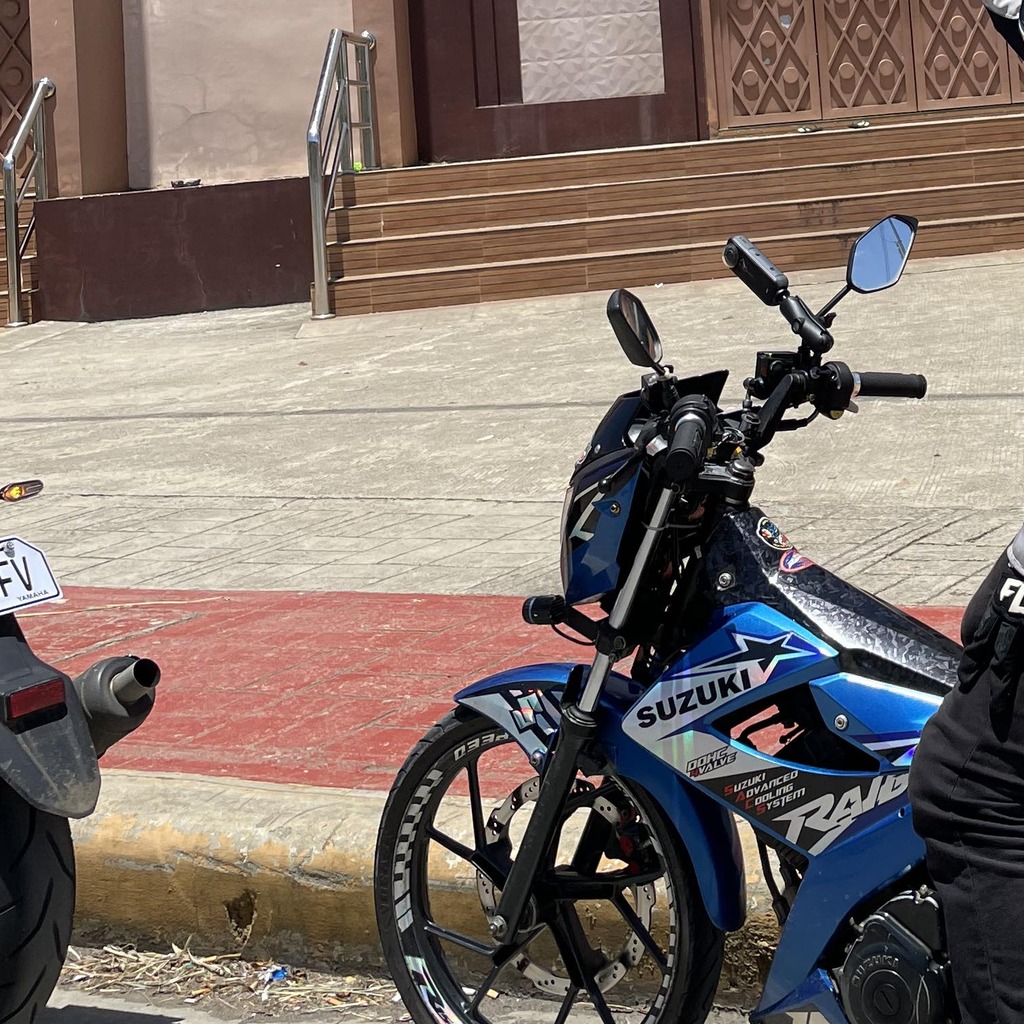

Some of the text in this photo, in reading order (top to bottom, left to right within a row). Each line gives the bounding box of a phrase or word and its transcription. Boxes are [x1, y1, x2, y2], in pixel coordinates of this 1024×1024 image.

[17, 589, 49, 602] YAMAHA
[636, 668, 752, 728] SUZUKI
[687, 746, 730, 773] DOHC
[724, 772, 766, 797] SUZUKI
[735, 770, 799, 803] ADVANCED
[744, 783, 794, 811] COOLING
[755, 787, 806, 816] SYSTEM
